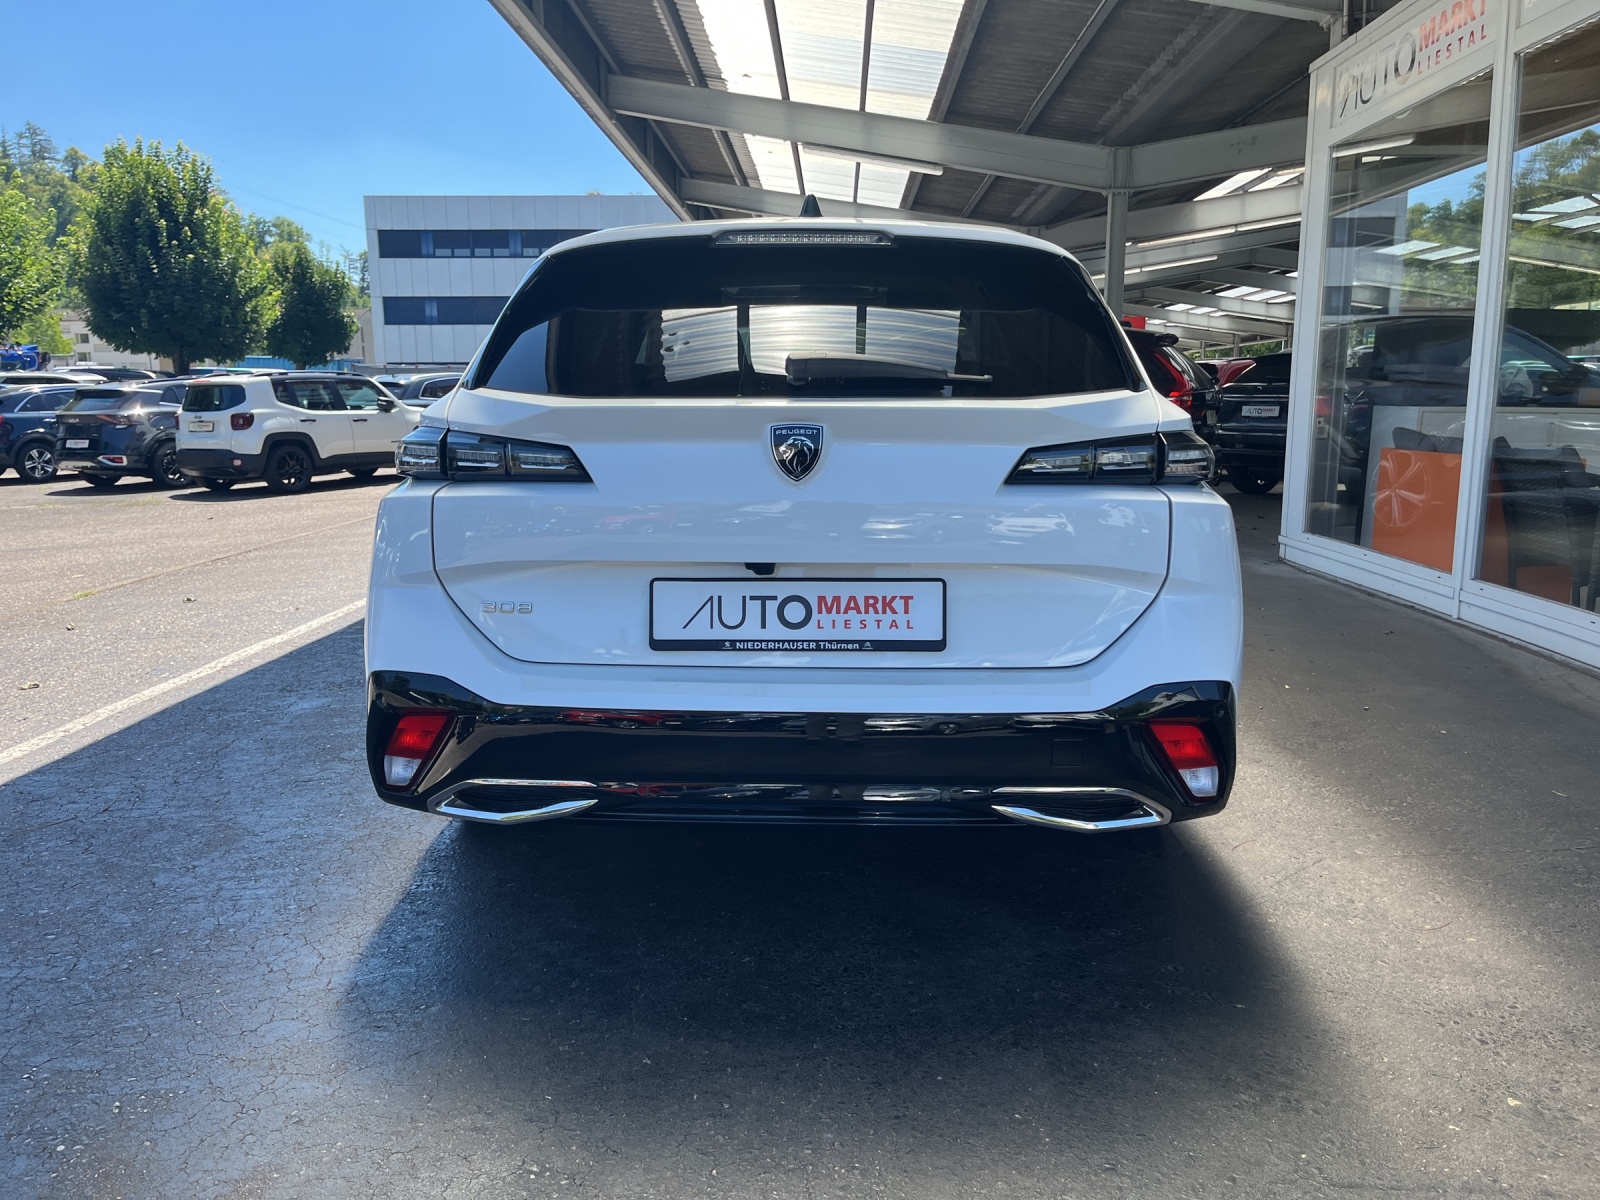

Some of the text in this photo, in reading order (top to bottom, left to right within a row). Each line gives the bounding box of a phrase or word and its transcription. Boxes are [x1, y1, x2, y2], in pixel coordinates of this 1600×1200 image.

[1417, 24, 1487, 75] LIESTAL
[1339, 0, 1486, 118] AUTO MARKT
[1245, 407, 1262, 415] AUTO
[482, 601, 533, 614] 308
[682, 594, 914, 630] AUTO MARKT
[817, 619, 914, 629] LIESTAL
[736, 641, 859, 649] NIEDERHAUSER Thürnen
